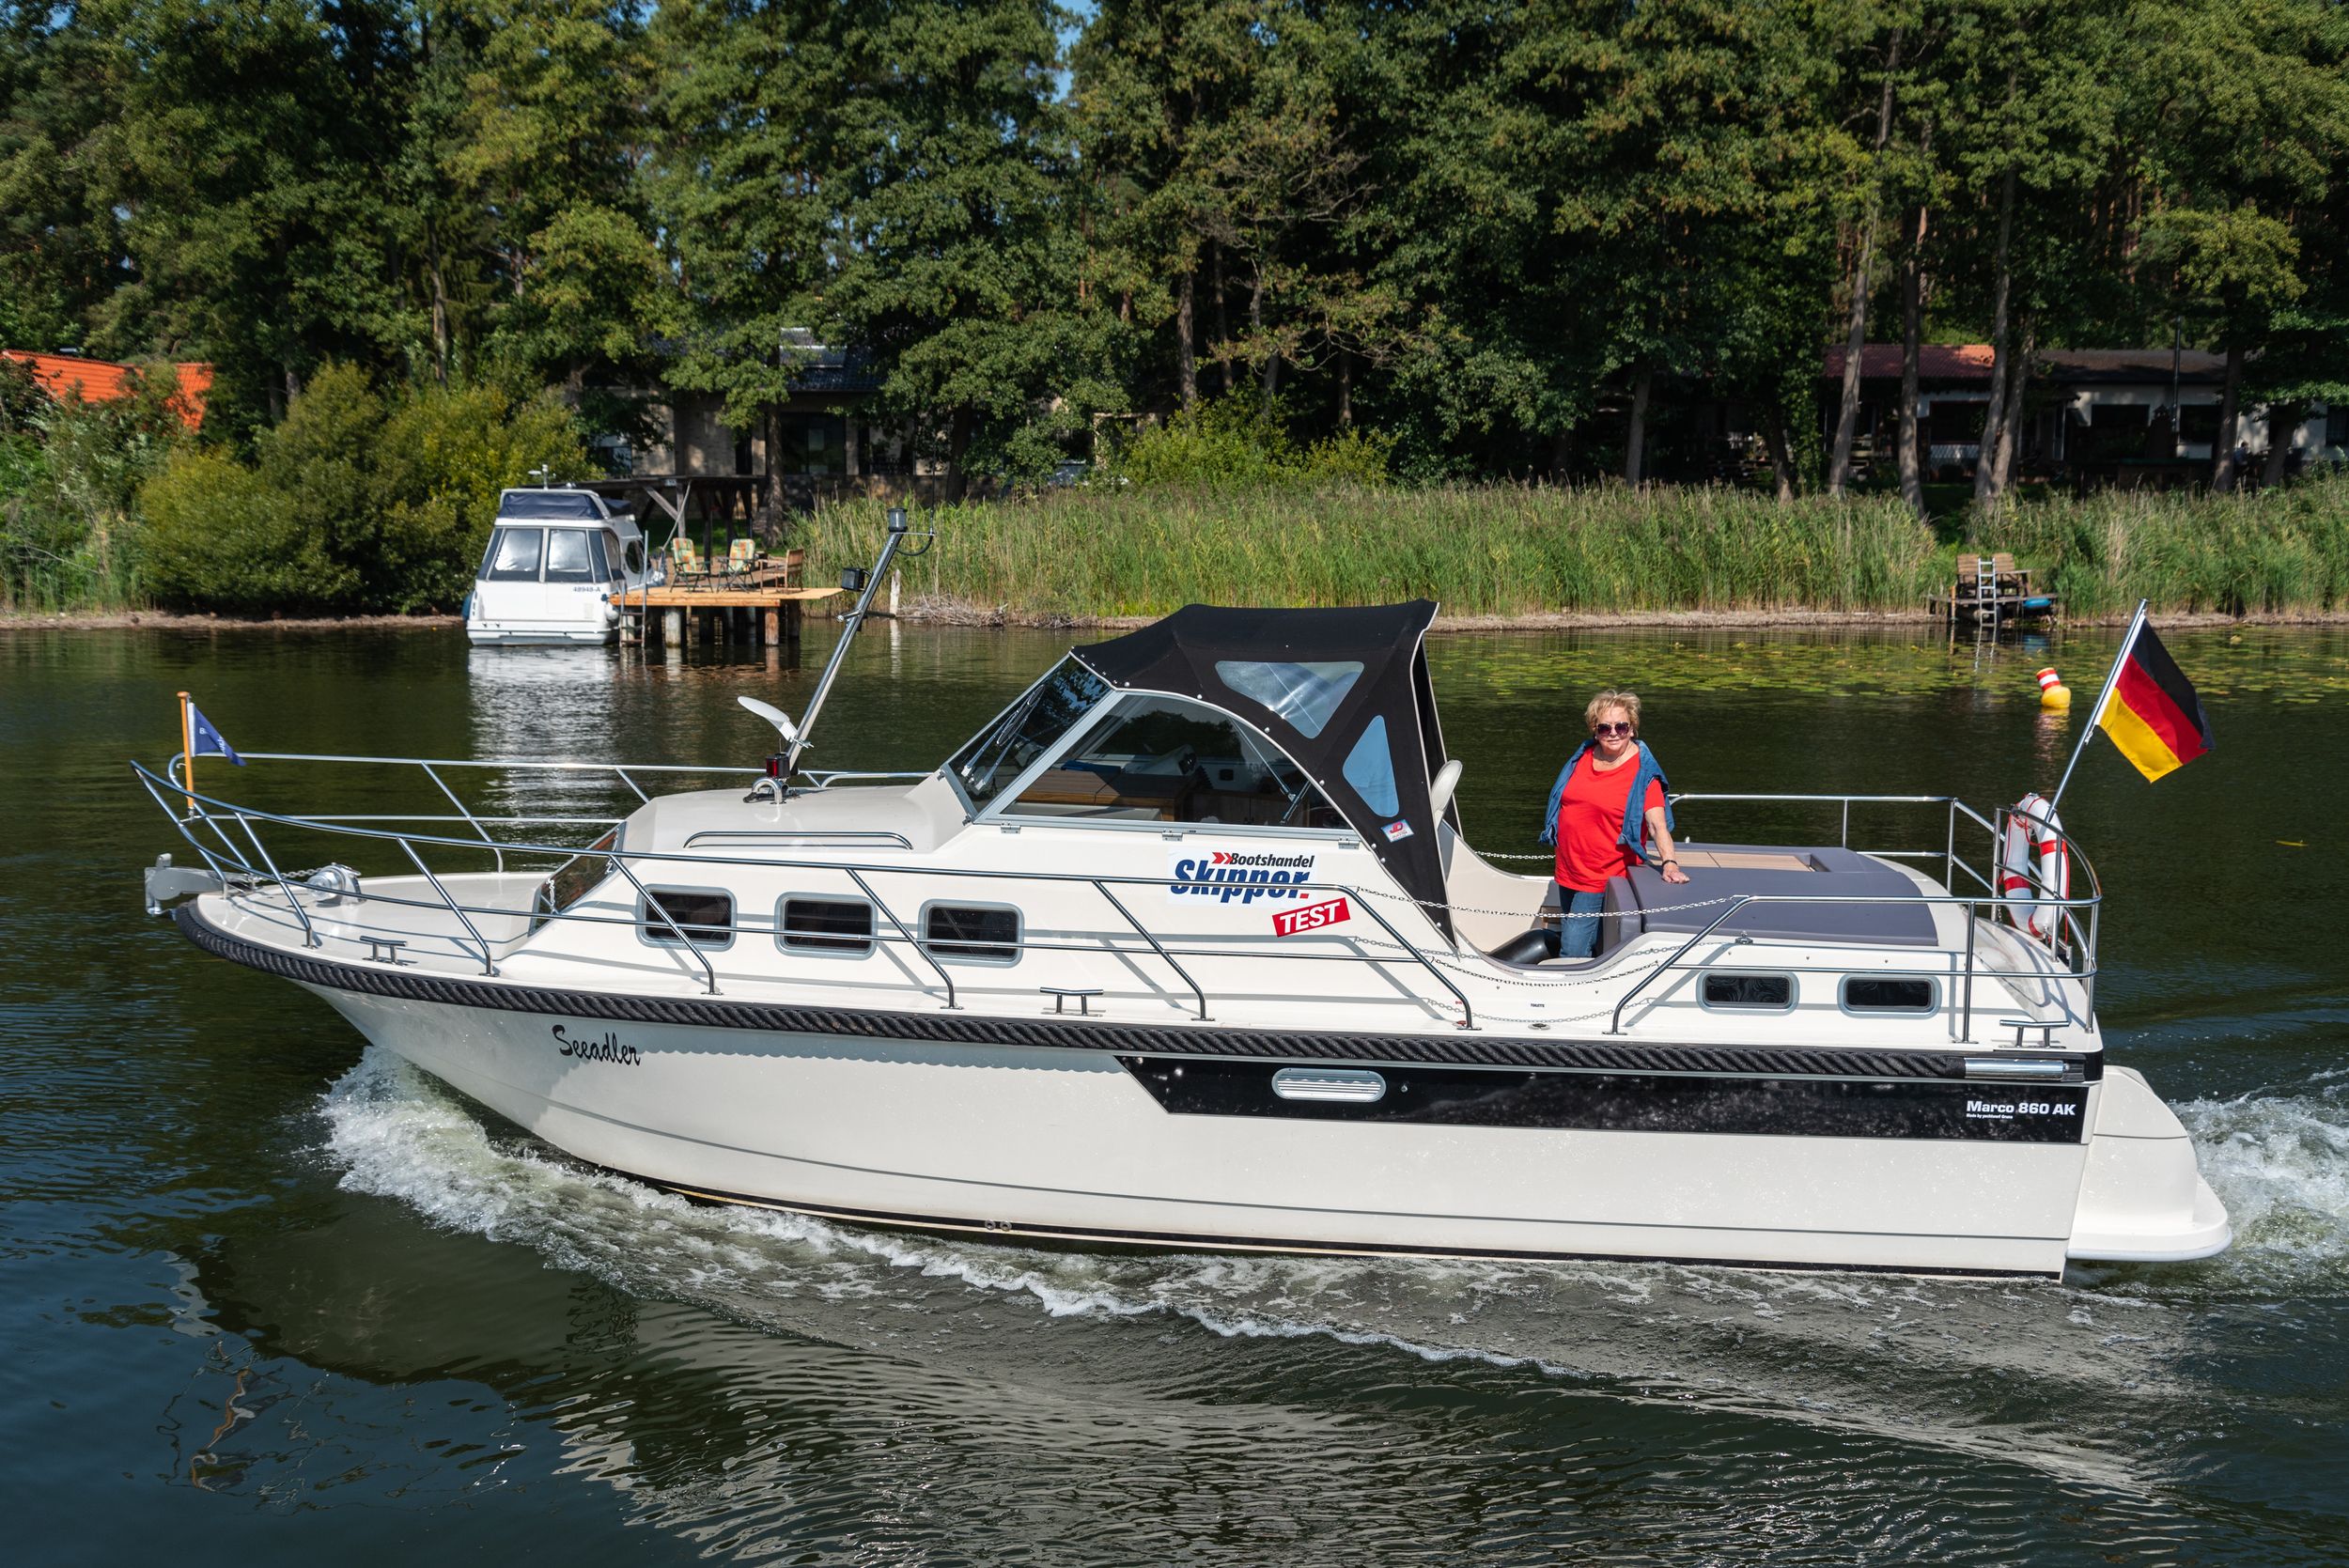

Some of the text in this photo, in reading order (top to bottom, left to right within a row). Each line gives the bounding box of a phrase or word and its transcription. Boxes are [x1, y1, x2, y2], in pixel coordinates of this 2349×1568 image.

[1230, 852, 1315, 868] Bootshandel
[1280, 901, 1341, 934] TEST
[552, 1024, 641, 1066] Seeadler
[1966, 1100, 2077, 1116] Marco 860 AK
